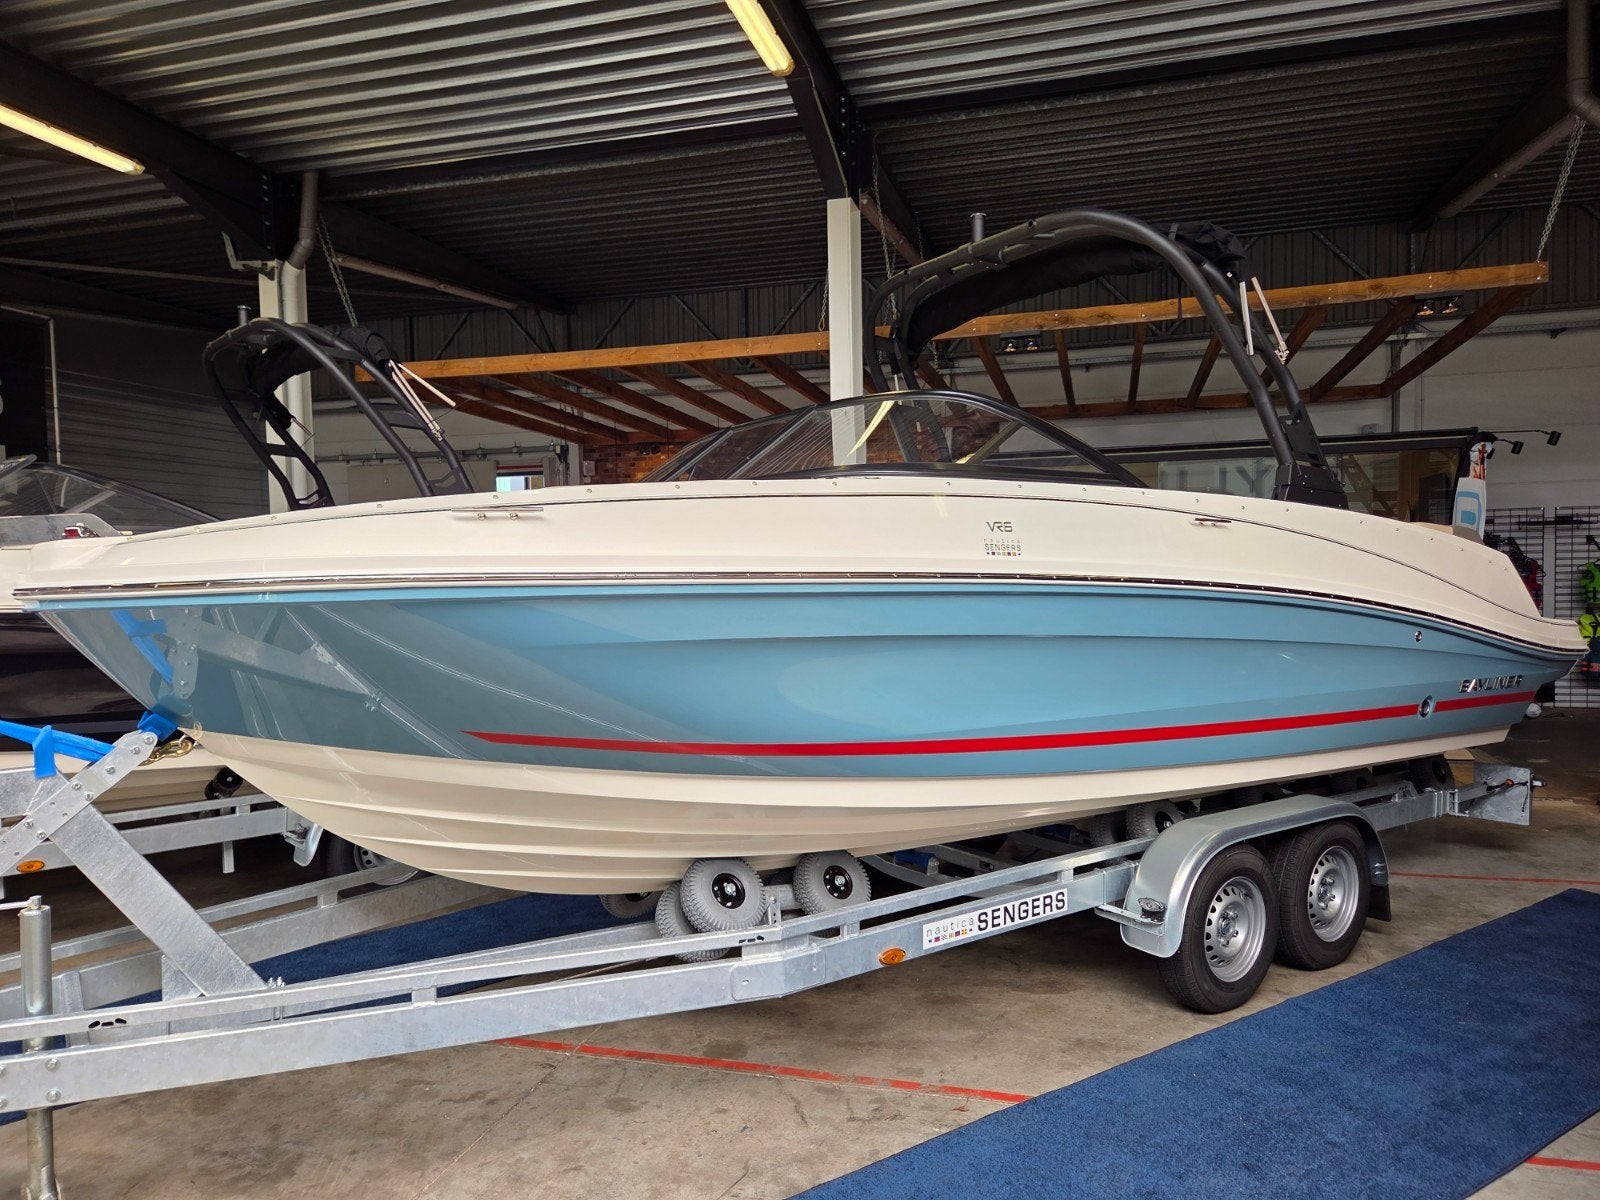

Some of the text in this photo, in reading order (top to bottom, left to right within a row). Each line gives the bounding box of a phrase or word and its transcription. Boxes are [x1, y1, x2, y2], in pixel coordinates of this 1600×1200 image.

[986, 521, 1013, 533] VR6
[984, 543, 1021, 552] SENGERS
[1459, 675, 1523, 693] BAYLINER
[926, 891, 1066, 938] nautica SENGERS
